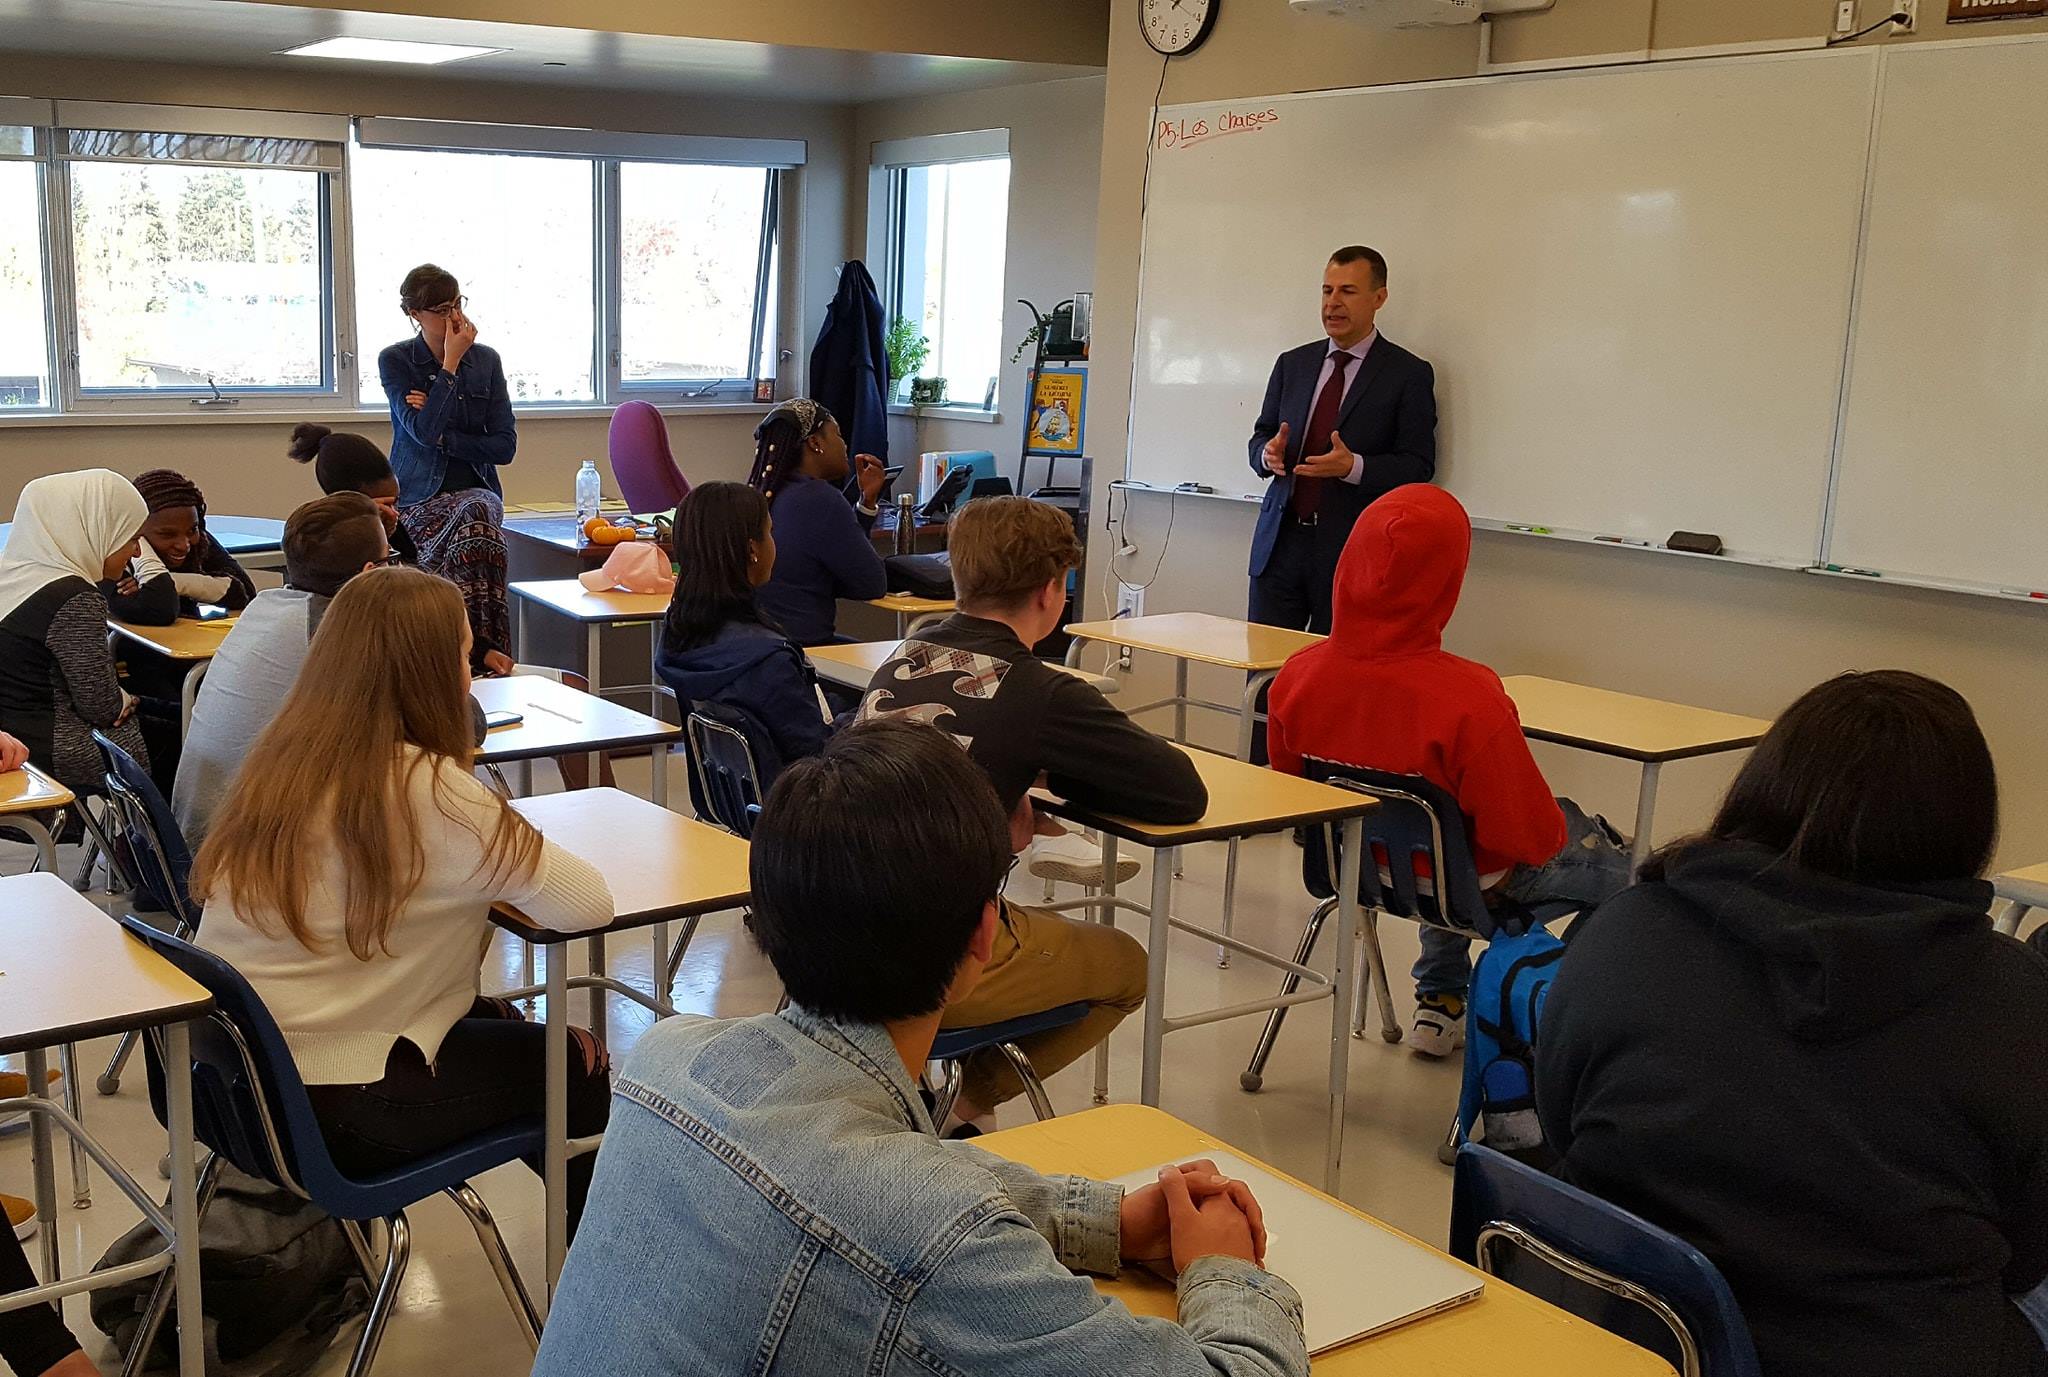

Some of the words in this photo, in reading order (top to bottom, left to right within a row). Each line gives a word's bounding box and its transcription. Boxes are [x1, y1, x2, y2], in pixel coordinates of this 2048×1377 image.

[1151, 17, 1157, 27] 8
[1195, 13, 1201, 23] 4
[1159, 30, 1165, 40] 7
[1184, 29, 1190, 39] 5
[1171, 35, 1177, 45] 6
